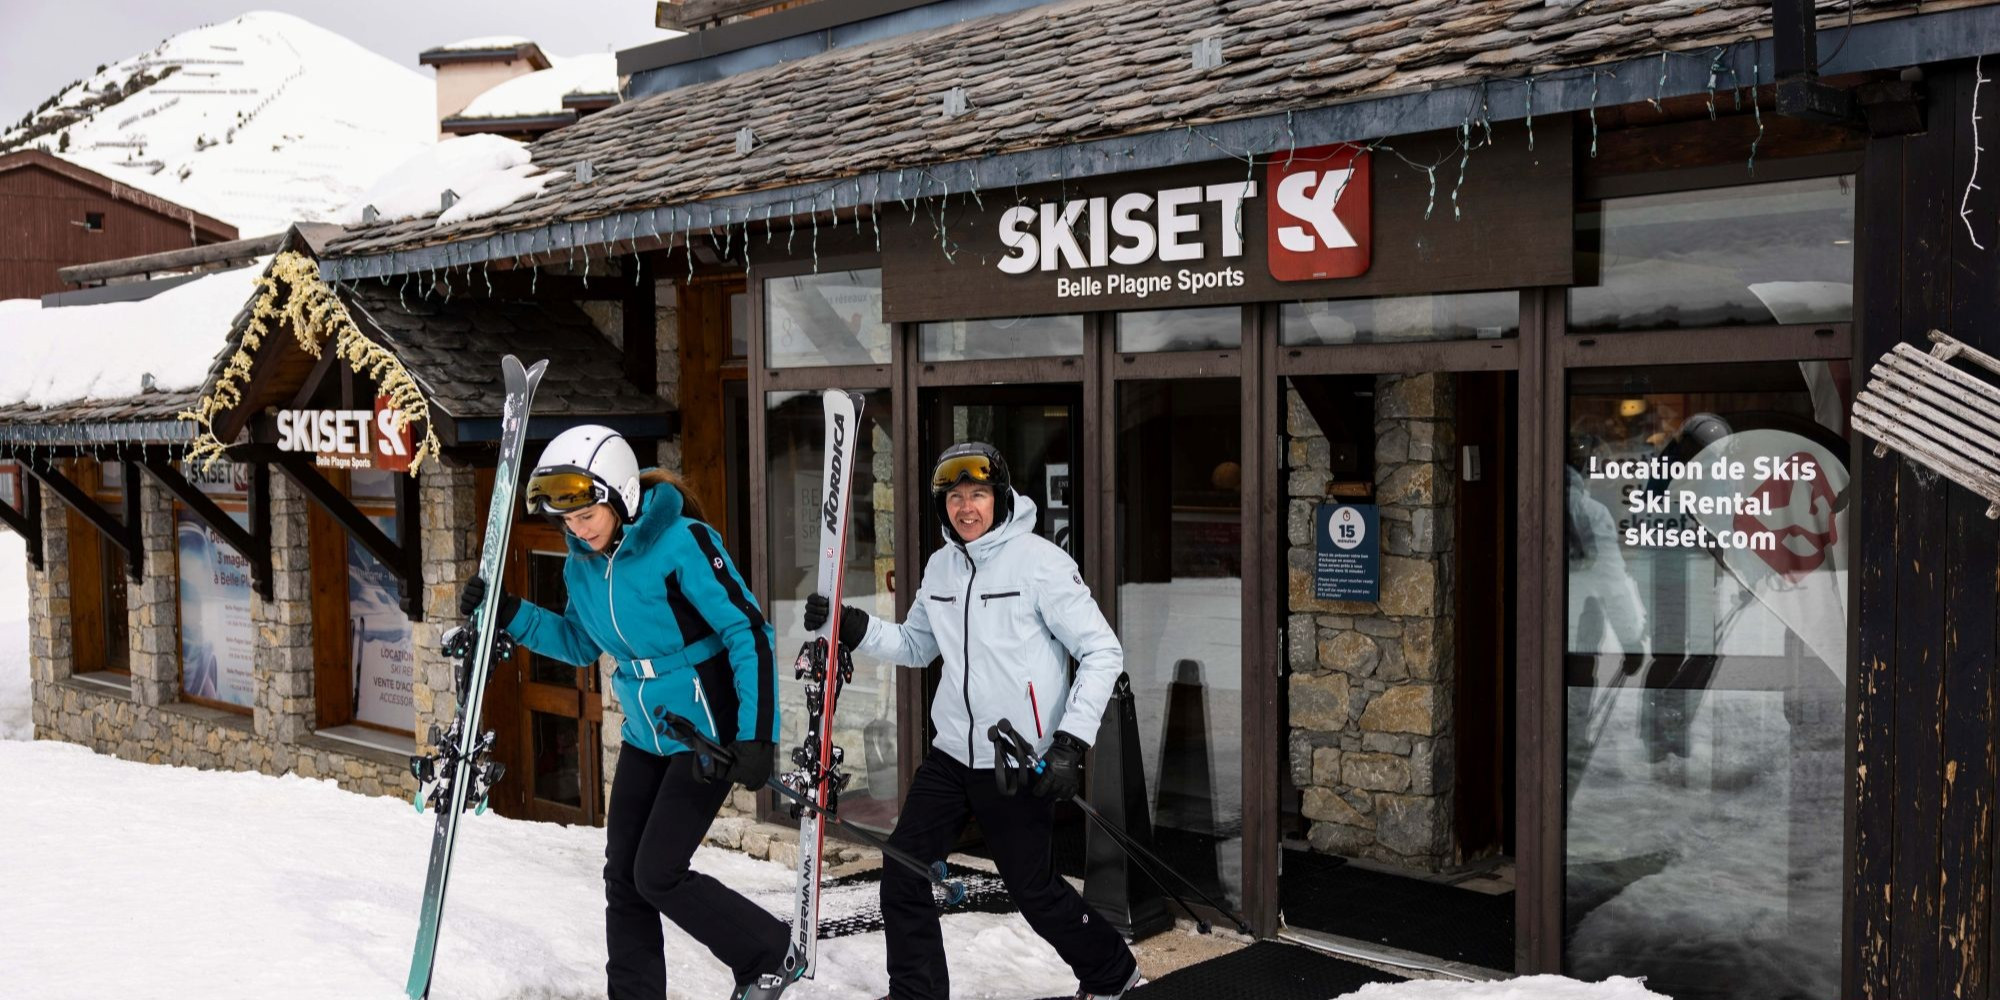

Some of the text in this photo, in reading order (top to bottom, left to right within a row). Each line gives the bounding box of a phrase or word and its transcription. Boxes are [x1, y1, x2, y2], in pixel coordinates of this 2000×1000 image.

[997, 180, 1258, 275] SKISET
[1057, 266, 1244, 298] Belle Plagne Sports
[277, 409, 374, 454] SKISET
[191, 463, 232, 484] SKISET
[316, 455, 371, 469] Belle Plagne Sports
[823, 413, 845, 536] NORDICA
[1590, 456, 1816, 481] Location de Skis
[1628, 490, 1772, 516] Ski Rental
[1339, 524, 1355, 538] 15
[1625, 523, 1776, 550] skiset.com
[220, 572, 239, 587] Belle
[373, 676, 394, 690] VENTE
[379, 692, 414, 708] ACCESSOR
[799, 855, 812, 961] OBERMANN
